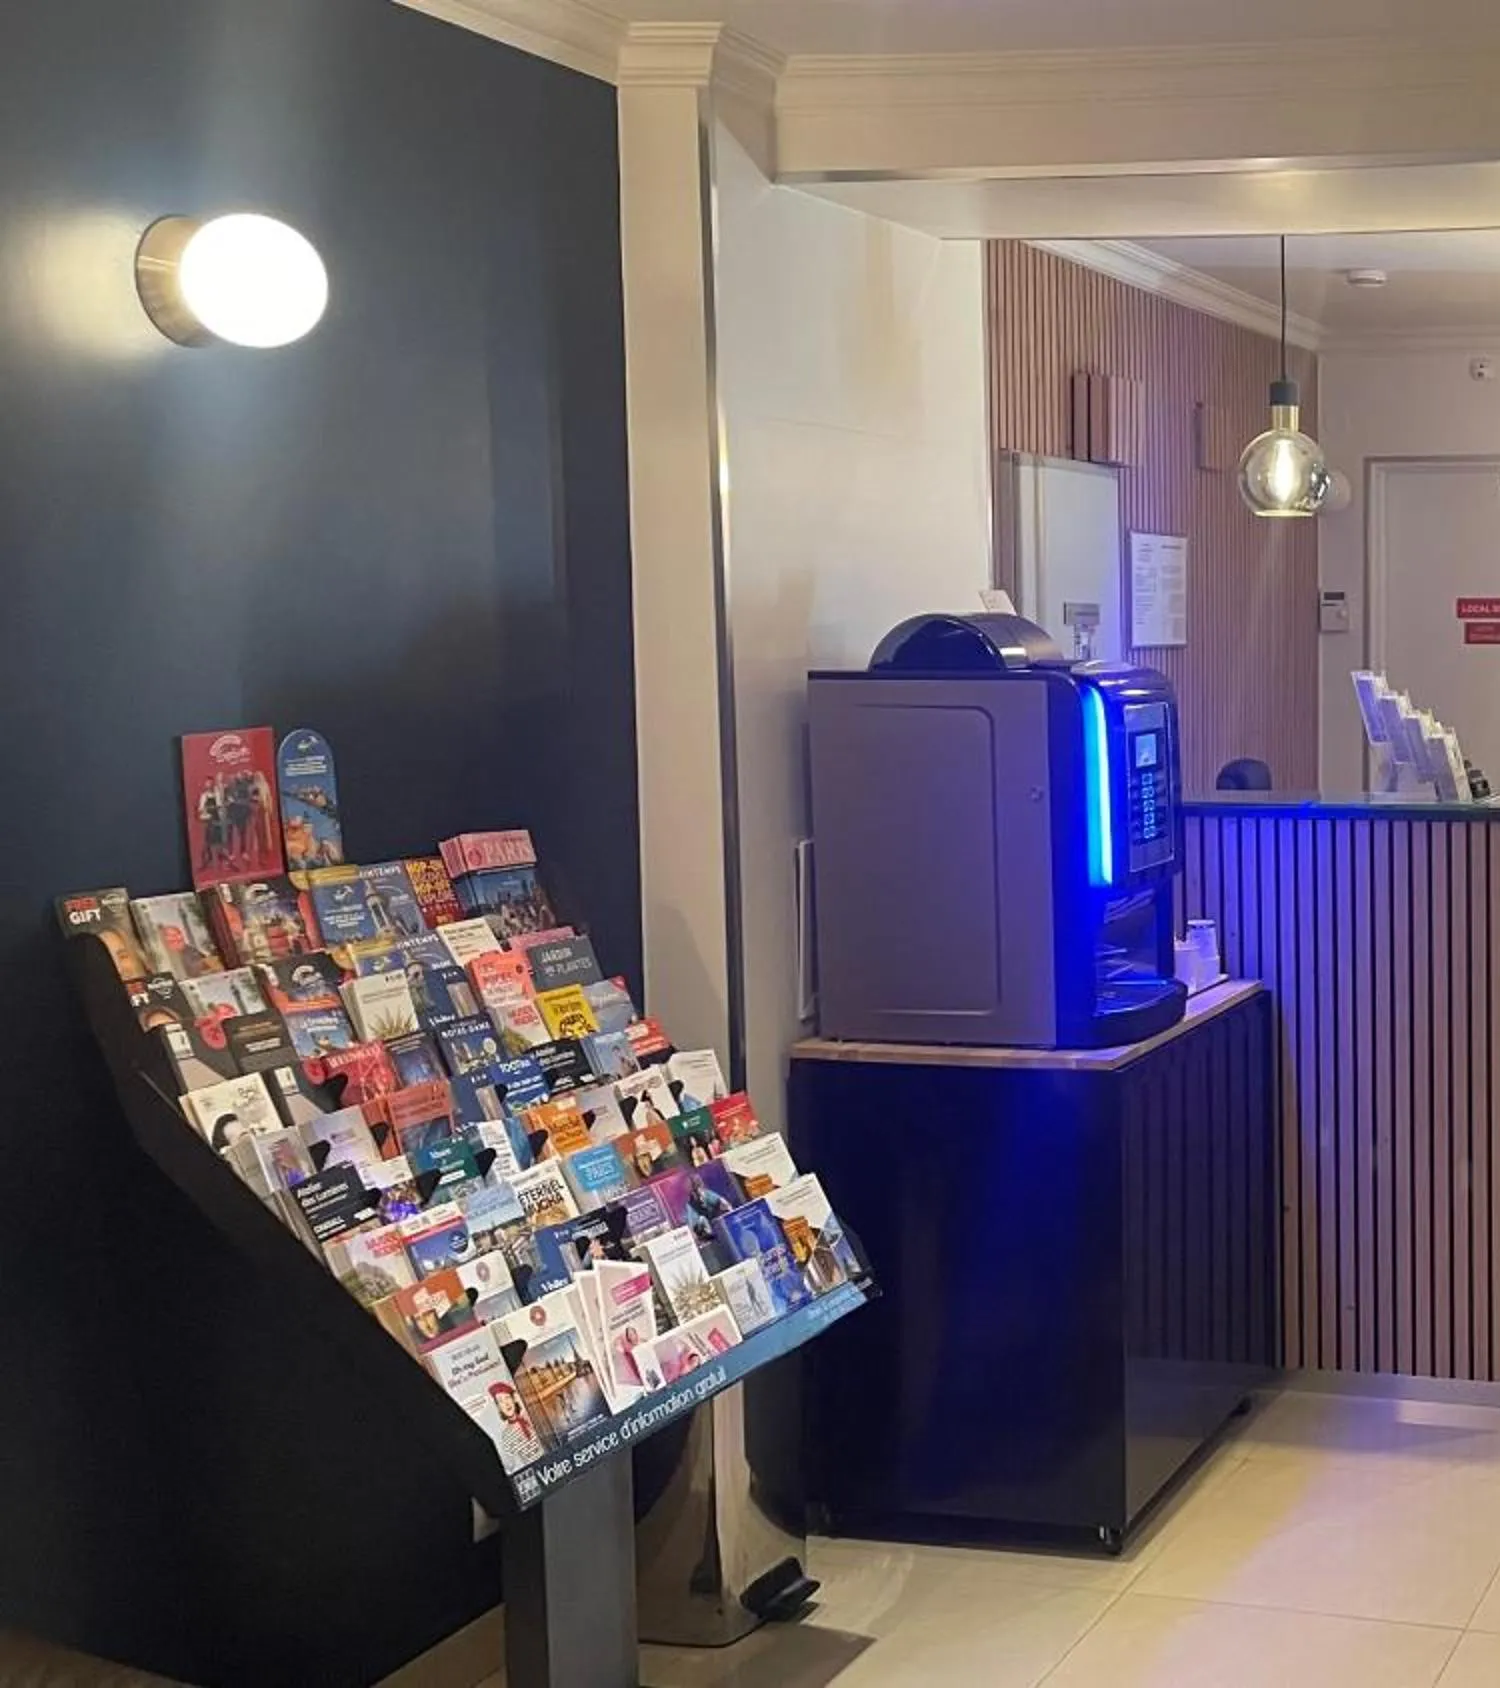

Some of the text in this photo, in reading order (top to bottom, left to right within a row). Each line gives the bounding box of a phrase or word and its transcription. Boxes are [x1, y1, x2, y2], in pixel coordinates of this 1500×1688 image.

[1461, 603, 1489, 614] LOCAL
[69, 908, 102, 925] GIFT
[535, 1459, 573, 1487] Votre
[574, 1431, 620, 1468] service
[620, 1388, 695, 1440] d'information
[694, 1366, 728, 1402] gratuit
